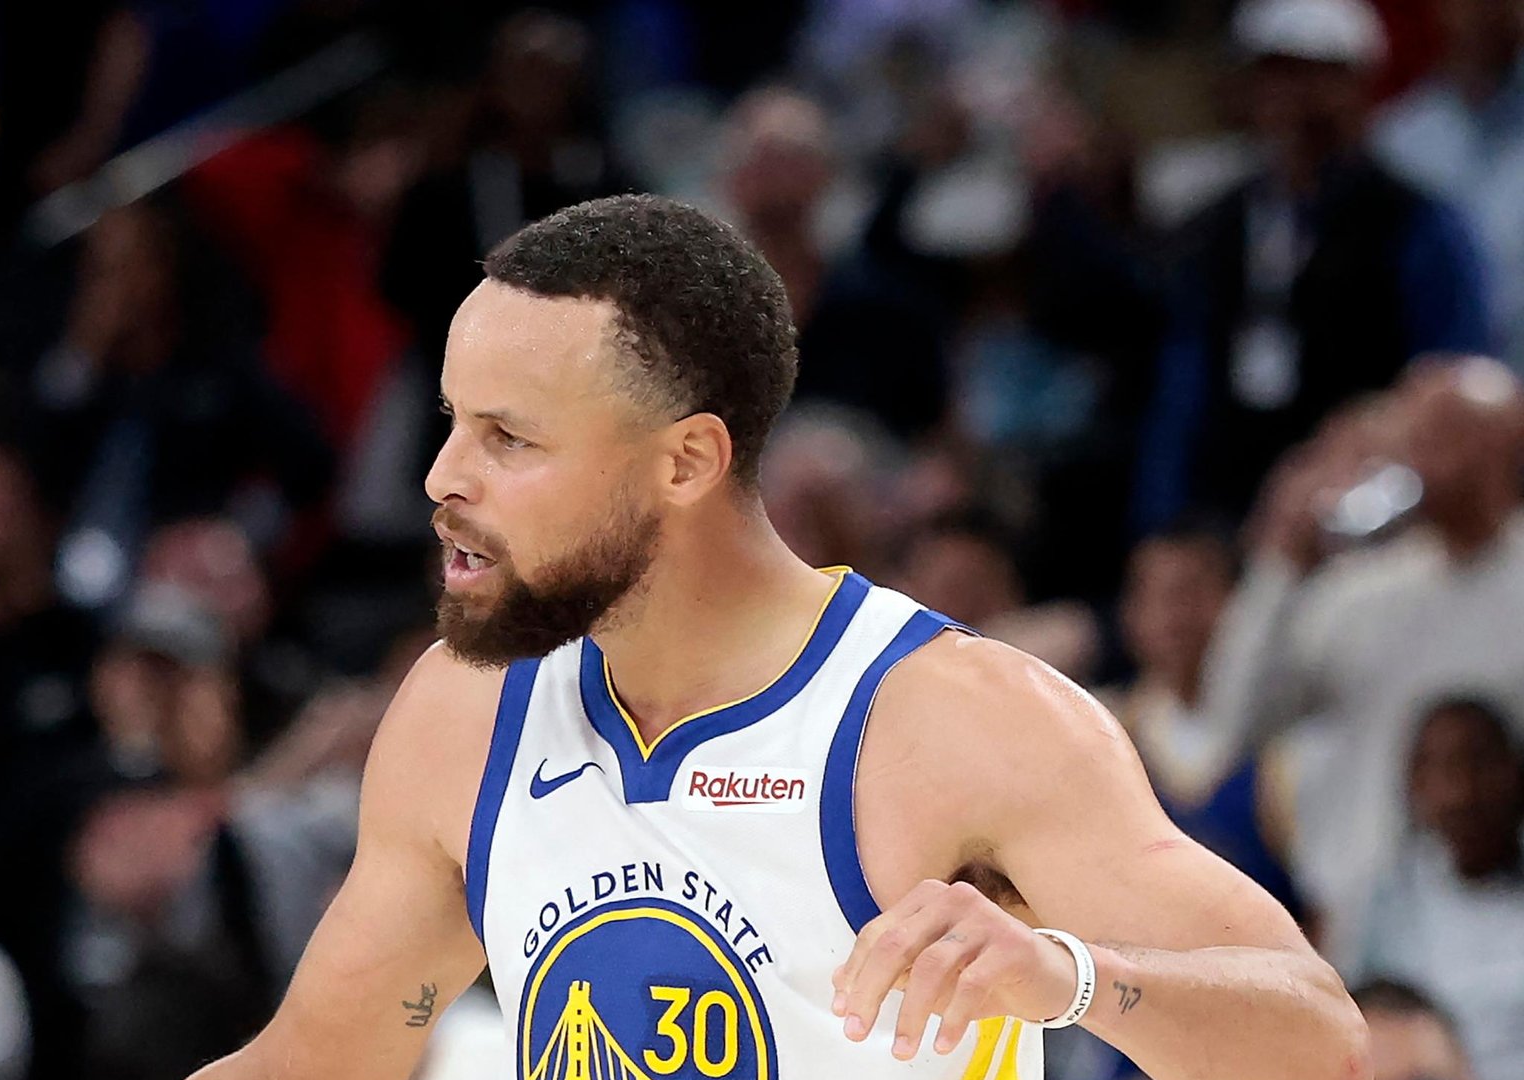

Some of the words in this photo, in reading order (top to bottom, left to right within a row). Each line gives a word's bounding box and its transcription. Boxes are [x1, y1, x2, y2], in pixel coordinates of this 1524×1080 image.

[688, 771, 805, 800] Rakuten
[523, 861, 664, 958] GOLDEN
[682, 871, 773, 973] STATE
[643, 985, 740, 1078] 30
[1067, 981, 1091, 1021] FAITH
